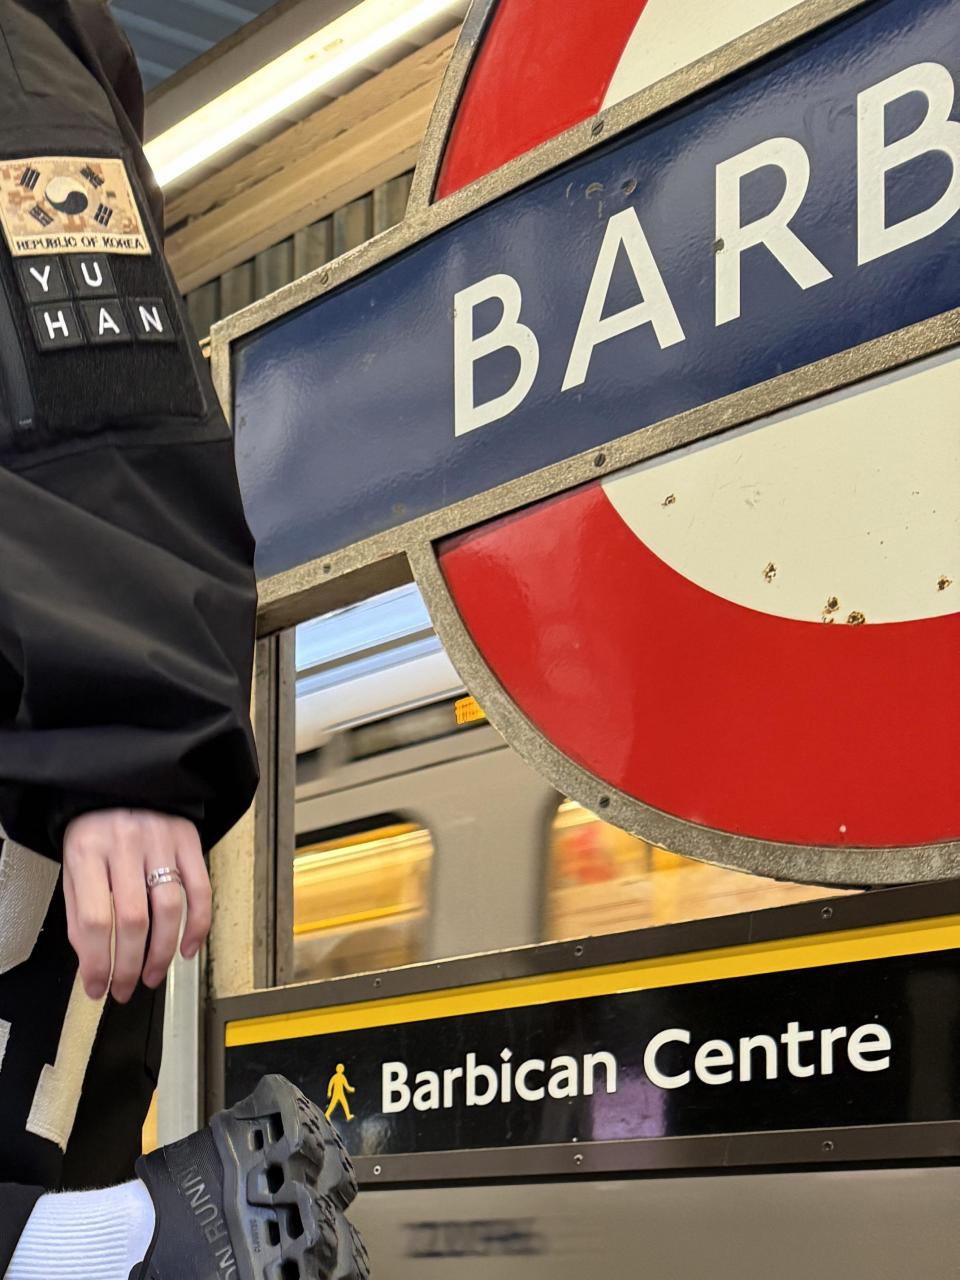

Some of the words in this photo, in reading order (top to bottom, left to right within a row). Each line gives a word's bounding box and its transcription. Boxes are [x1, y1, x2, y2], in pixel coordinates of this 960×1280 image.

[16, 236, 77, 250] REPUBLIC
[80, 236, 98, 248] OF
[102, 236, 144, 250] KOREA
[453, 62, 960, 437] BARB
[380, 1047, 618, 1115] Barbican
[643, 1020, 892, 1090] Centre
